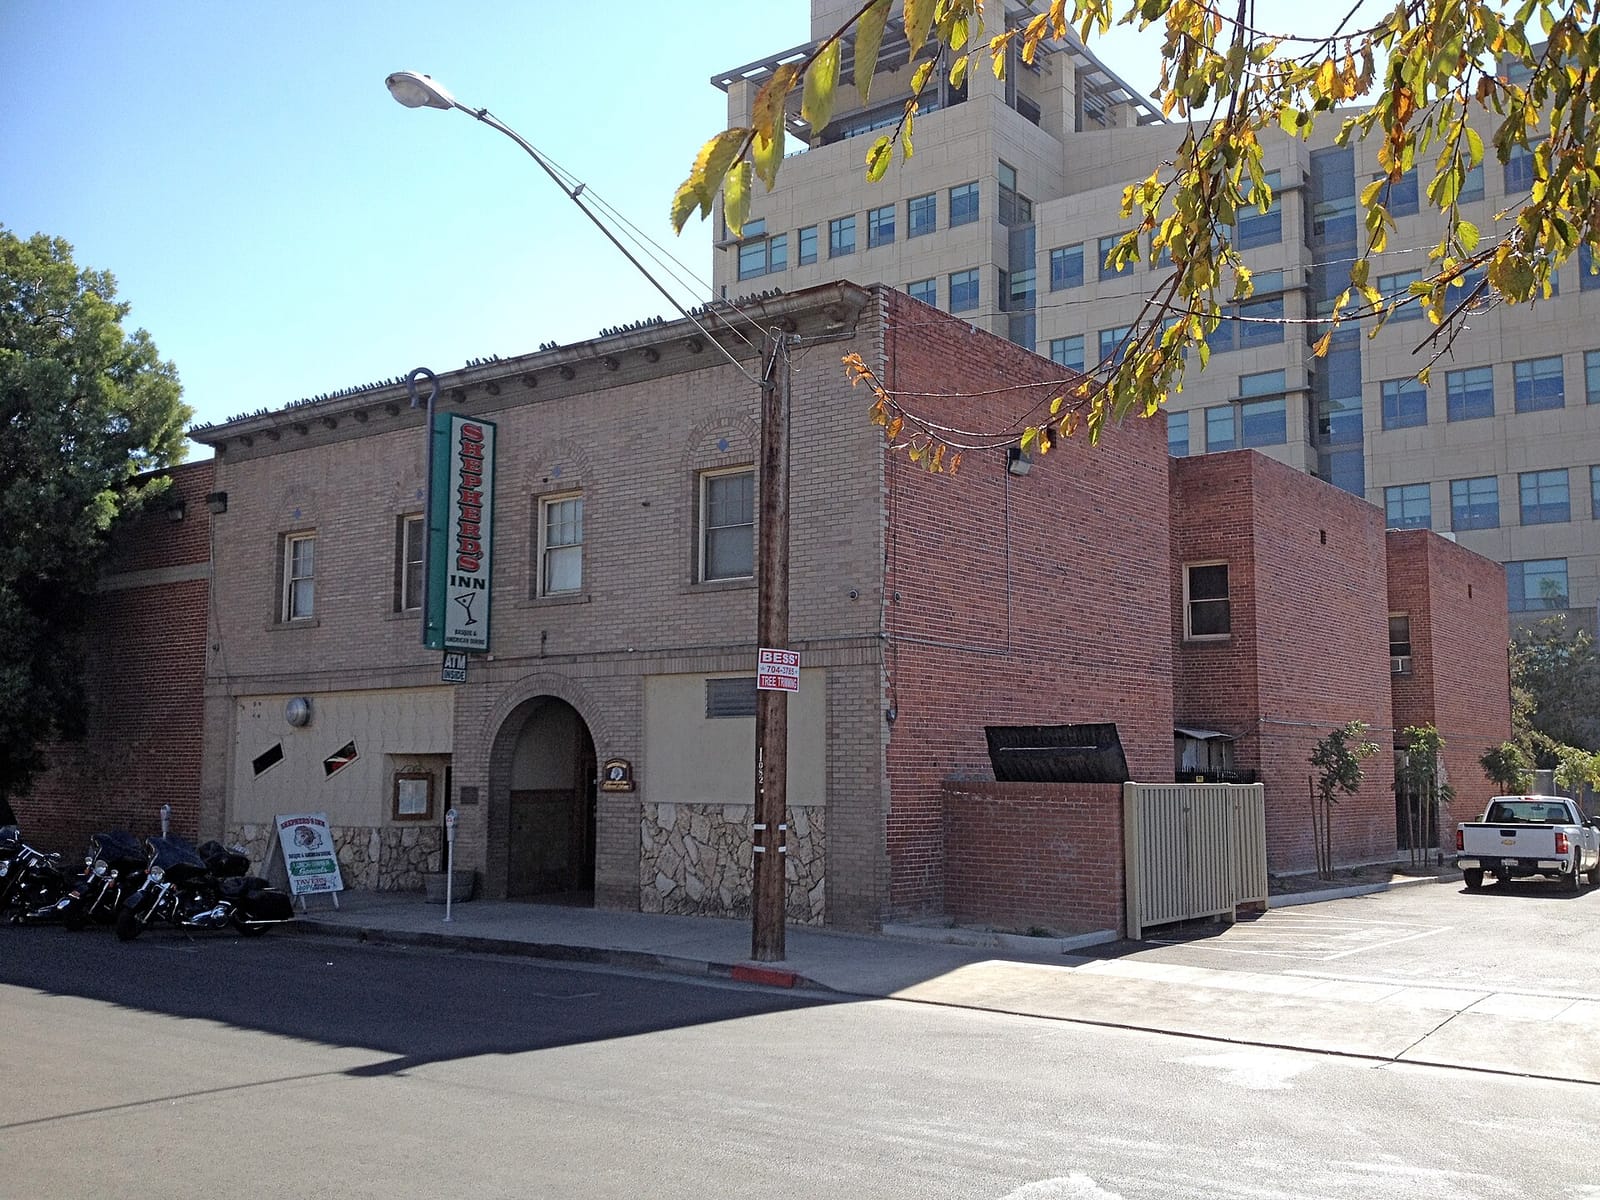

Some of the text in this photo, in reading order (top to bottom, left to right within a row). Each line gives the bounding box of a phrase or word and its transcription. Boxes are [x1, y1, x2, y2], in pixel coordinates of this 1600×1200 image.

[450, 574, 485, 590] INN
[444, 654, 466, 669] ATM
[761, 676, 777, 687] TREE
